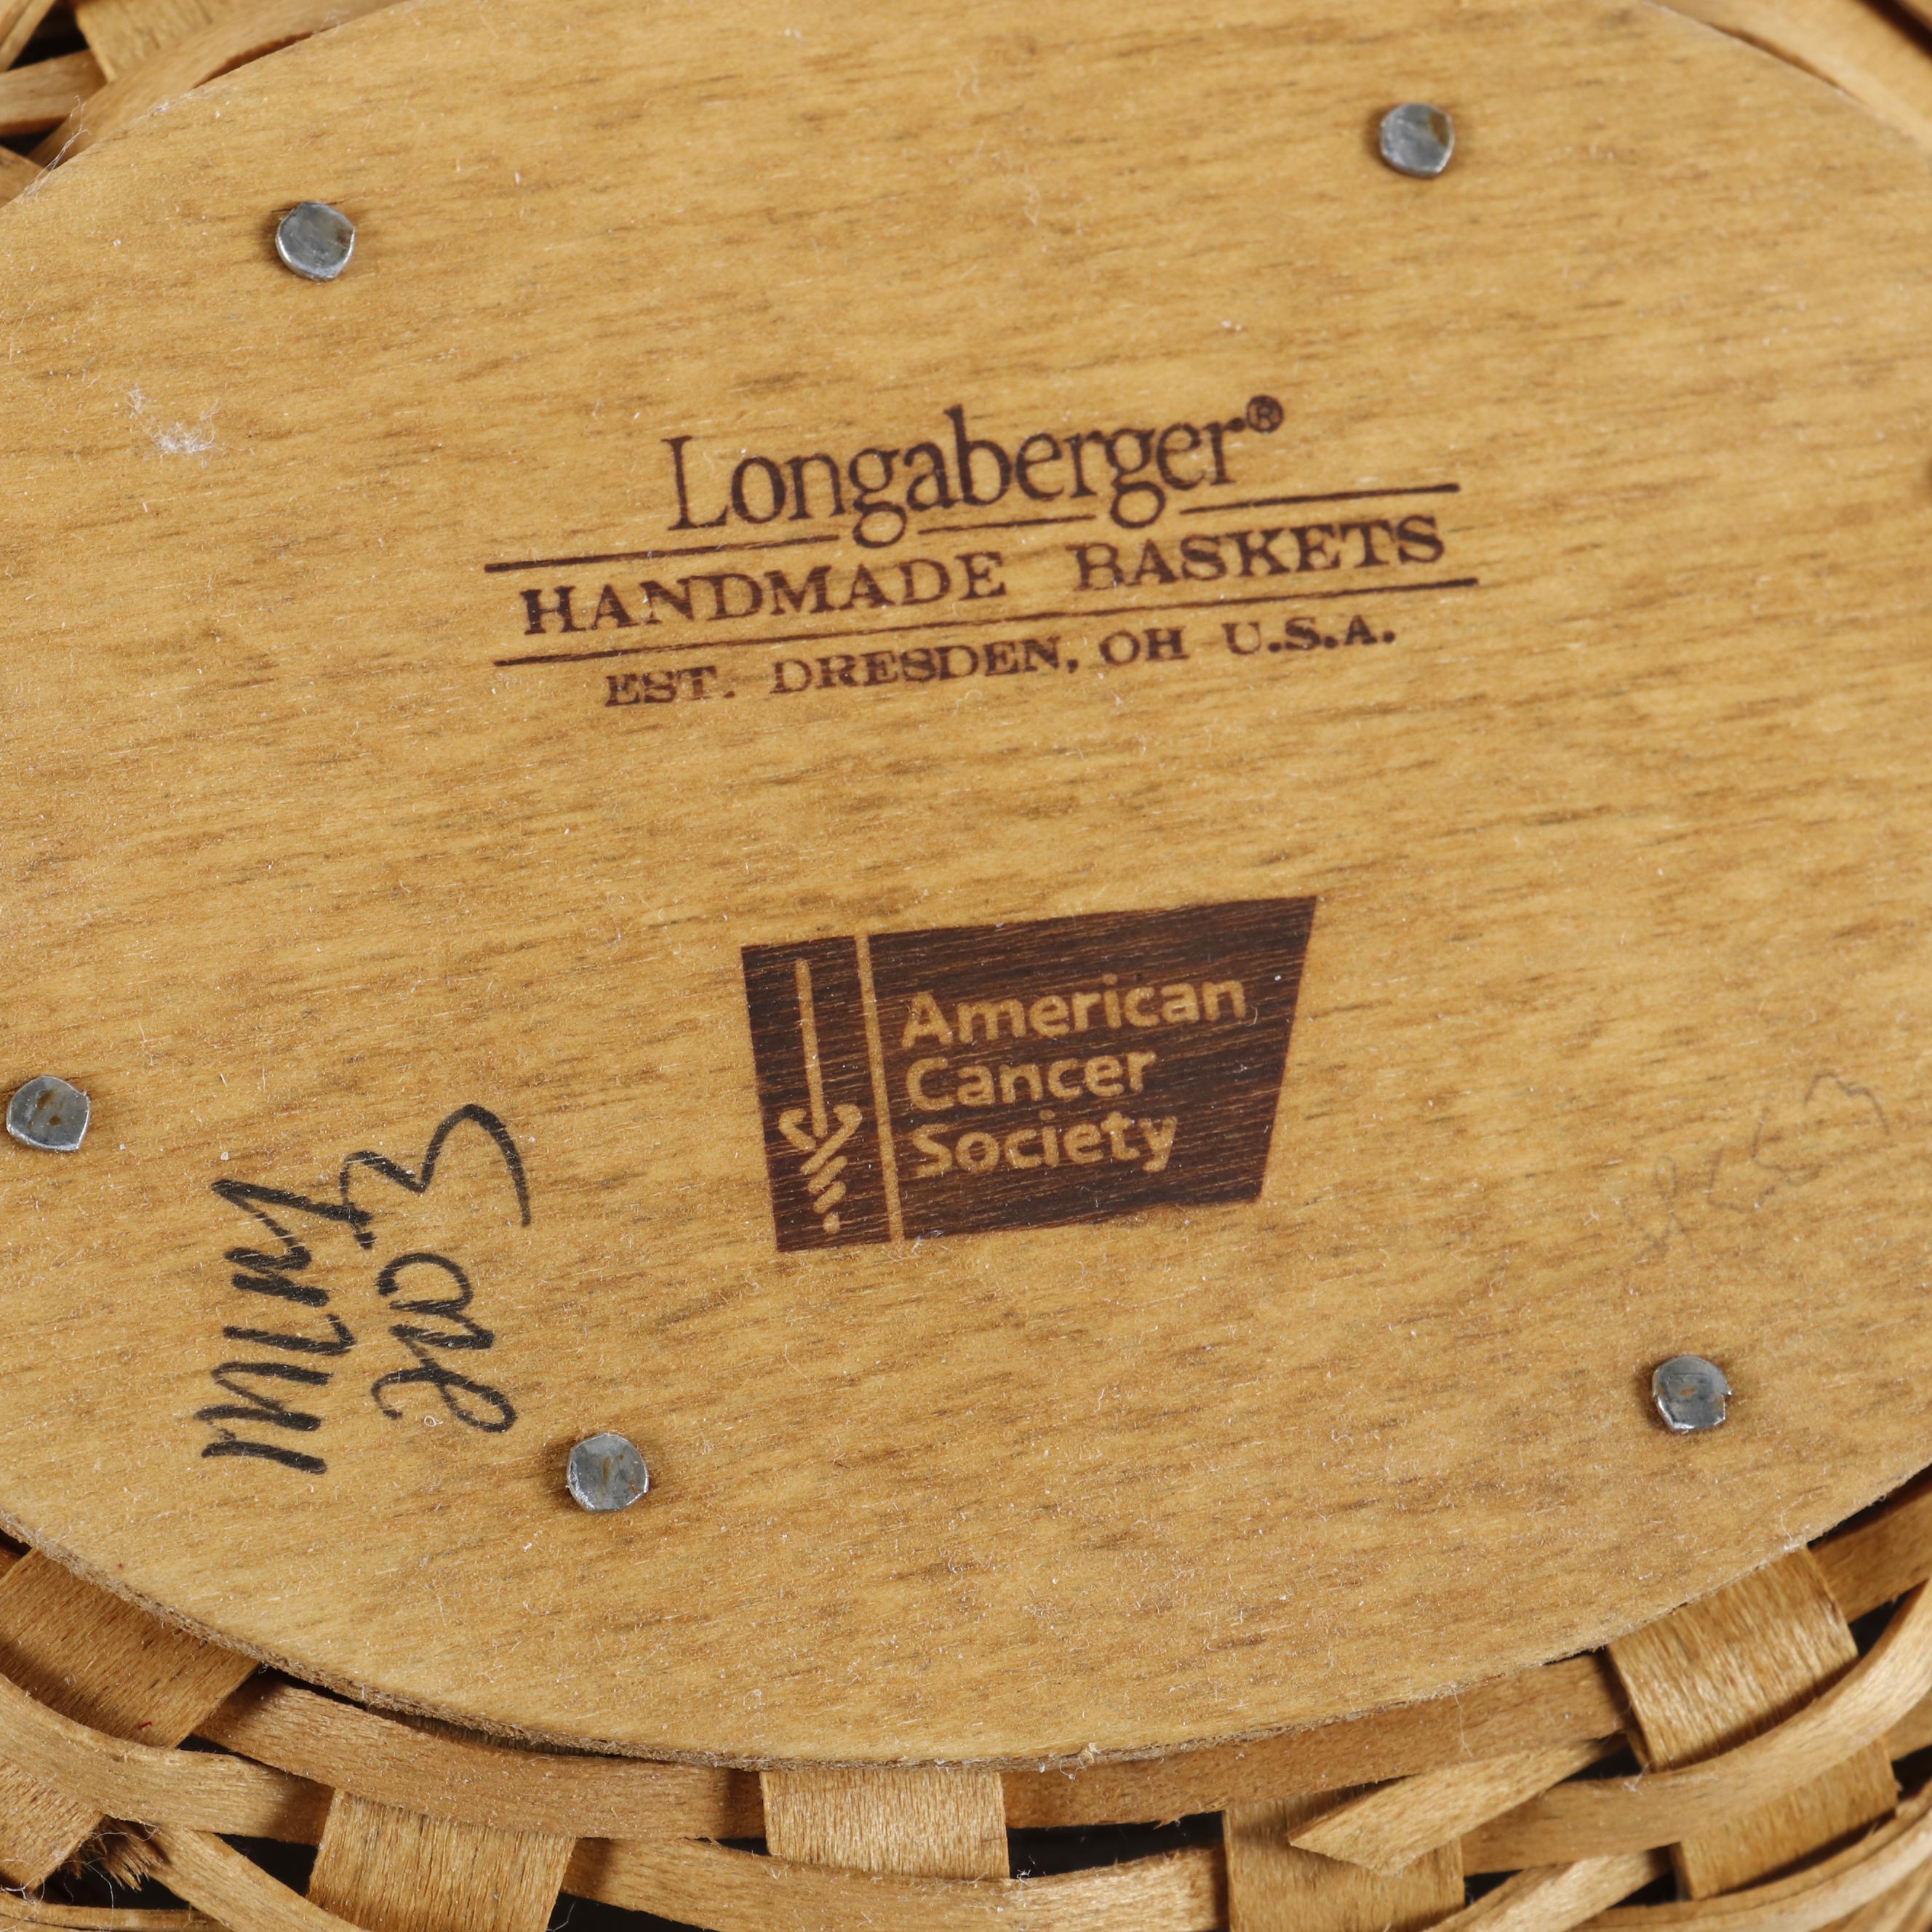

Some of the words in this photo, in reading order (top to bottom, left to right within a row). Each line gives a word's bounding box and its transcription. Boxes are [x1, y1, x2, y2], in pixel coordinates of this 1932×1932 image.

[520, 551, 1007, 636] HANDMADE
[1065, 514, 1445, 591] BASKETS
[604, 665, 735, 707] EST.
[769, 635, 1078, 695] DRESDEN,
[1099, 626, 1190, 668] OH
[1221, 614, 1396, 656] U.S.A.
[901, 973, 1247, 1048] American
[906, 1050, 1157, 1111] Cancer
[911, 1109, 1178, 1177] Society
